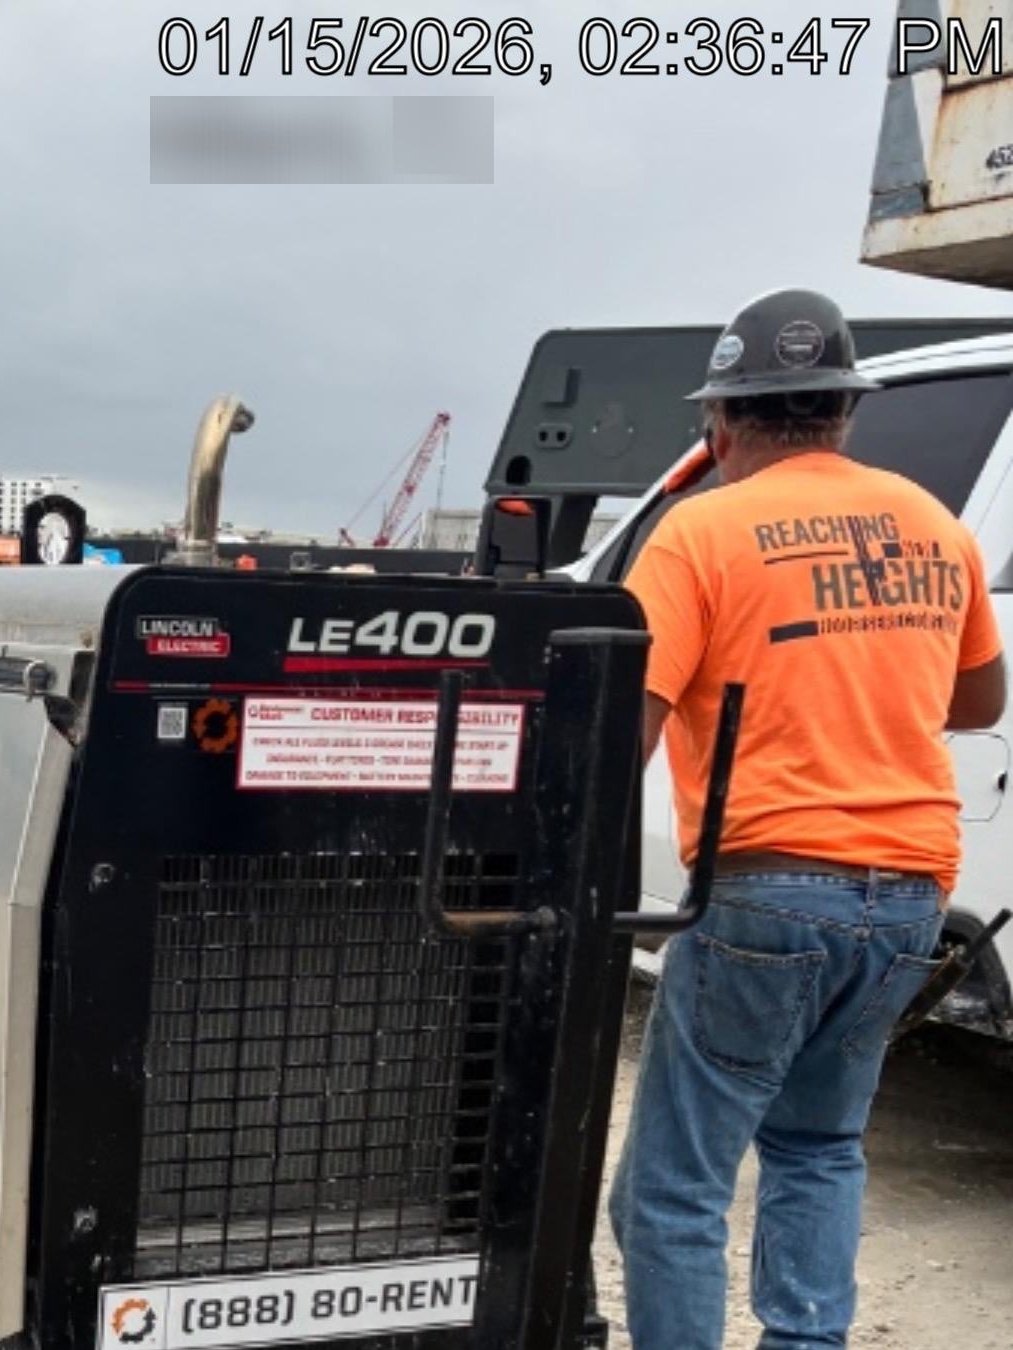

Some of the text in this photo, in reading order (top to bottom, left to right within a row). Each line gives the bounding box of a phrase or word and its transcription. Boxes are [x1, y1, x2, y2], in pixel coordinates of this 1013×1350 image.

[754, 512, 900, 552] REACHING
[811, 559, 964, 612] HEIGHTS
[141, 619, 214, 637] LINCOLN
[156, 638, 222, 653] ELECTRIC
[287, 610, 496, 658] LE400
[310, 706, 393, 722] CUSTOMER
[181, 1276, 478, 1333] (888) 80-RENT
